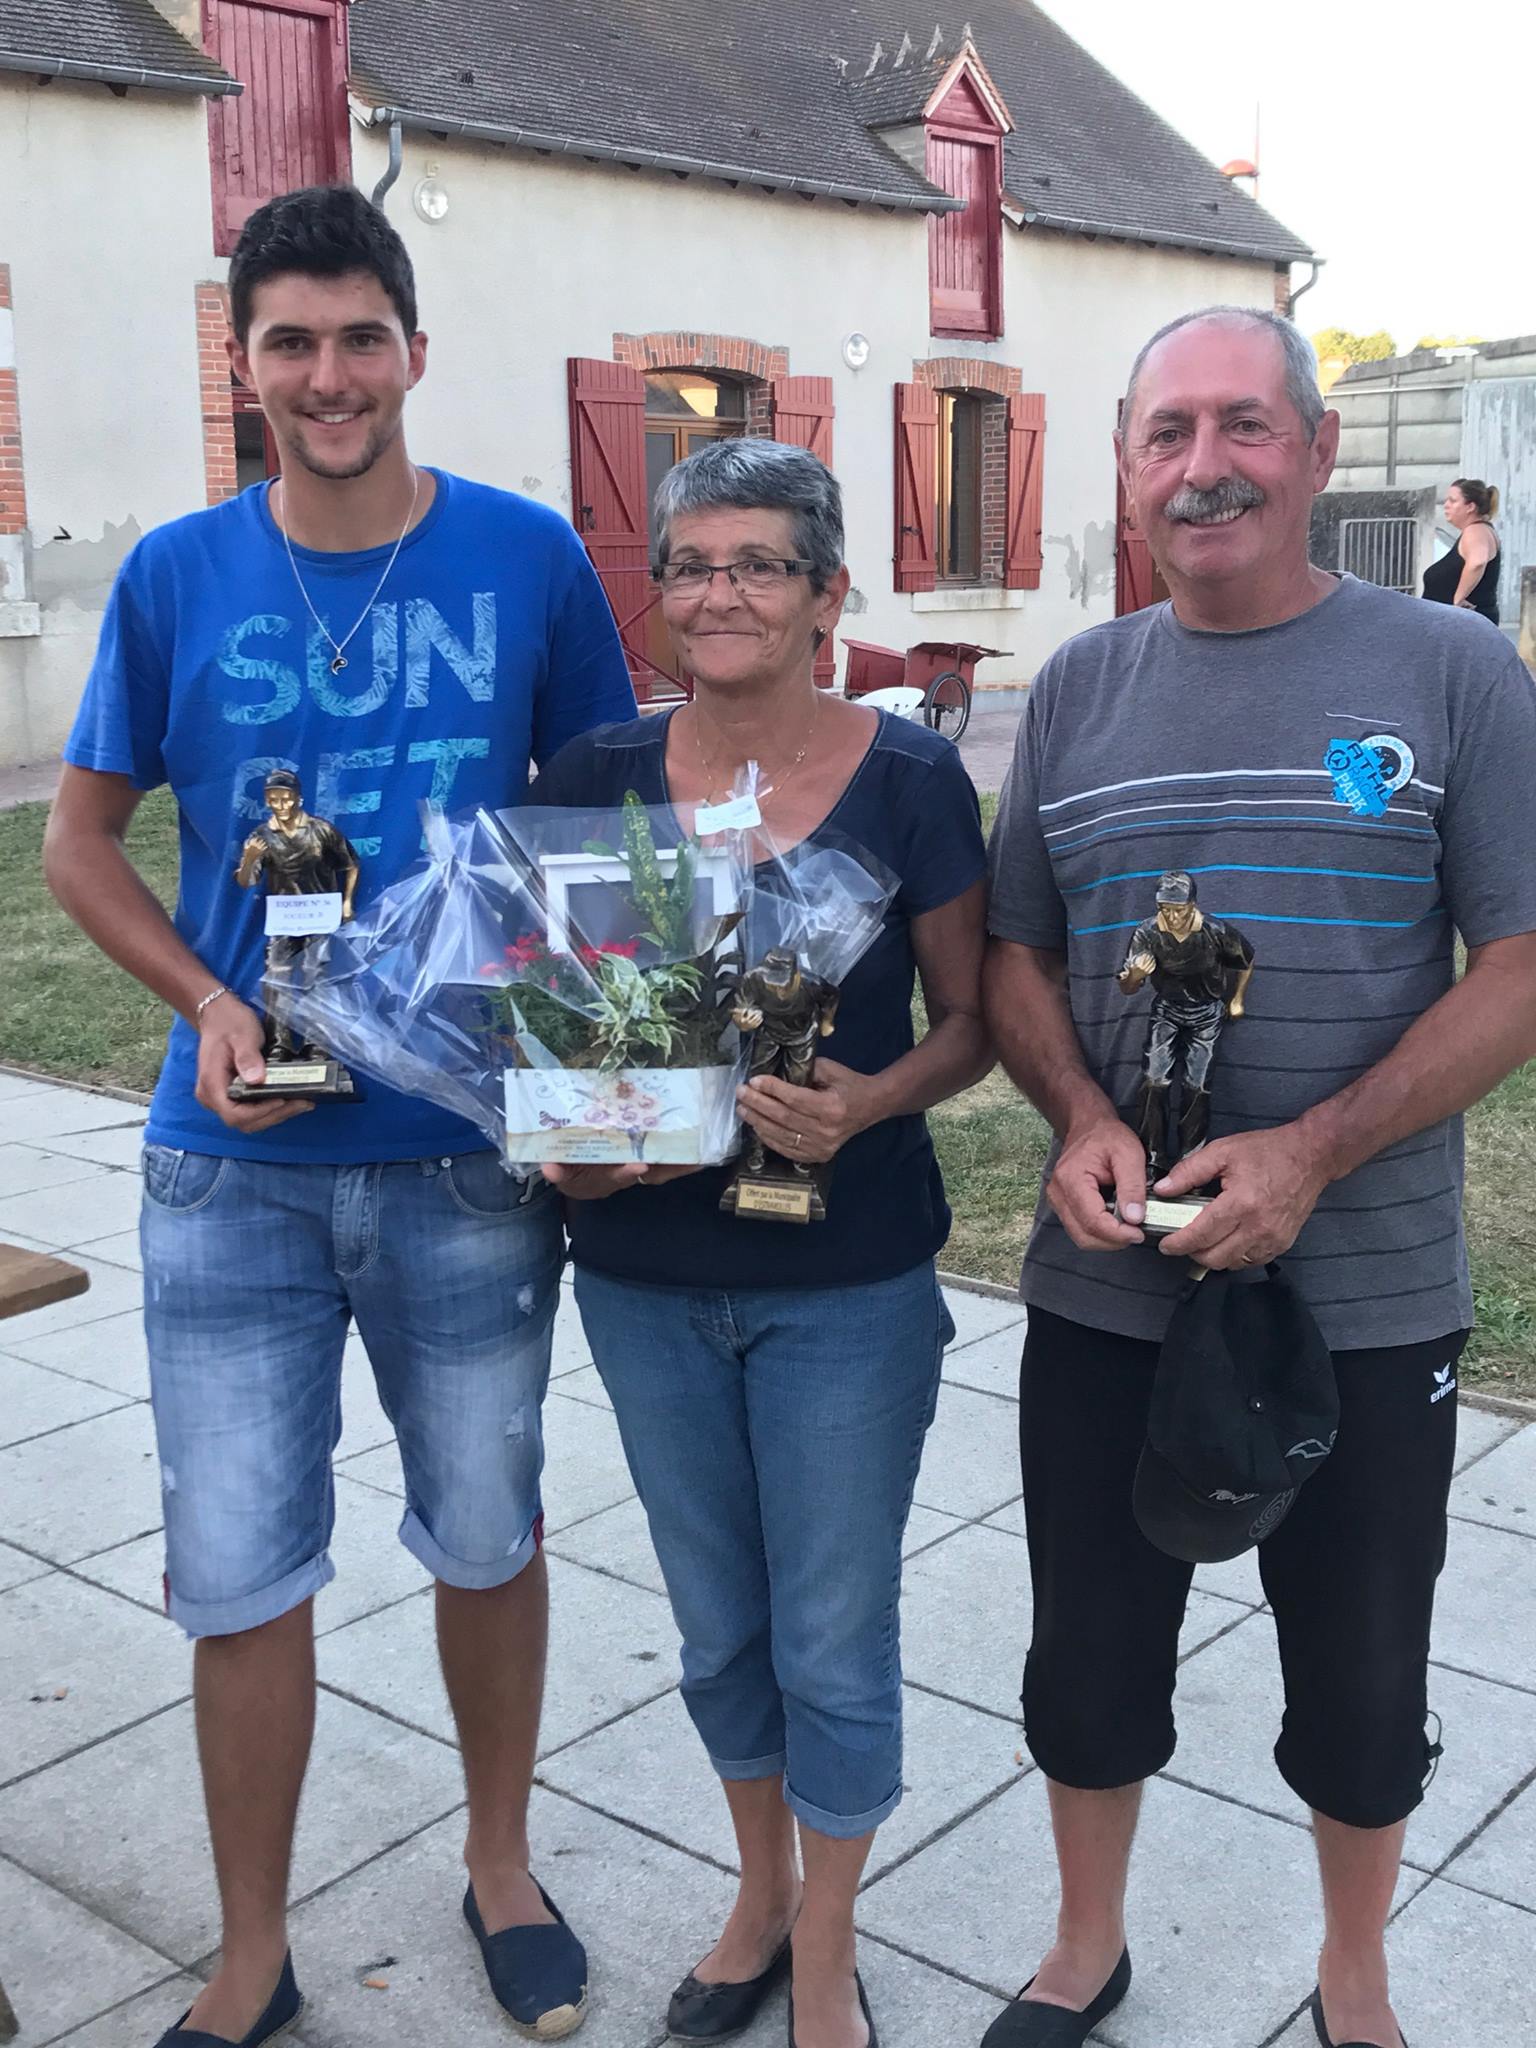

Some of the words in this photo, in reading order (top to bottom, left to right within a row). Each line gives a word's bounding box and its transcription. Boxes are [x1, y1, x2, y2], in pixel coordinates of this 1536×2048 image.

[217, 592, 497, 725] SUN
[1336, 772, 1368, 812] PARK
[1430, 1378, 1456, 1404] erima
